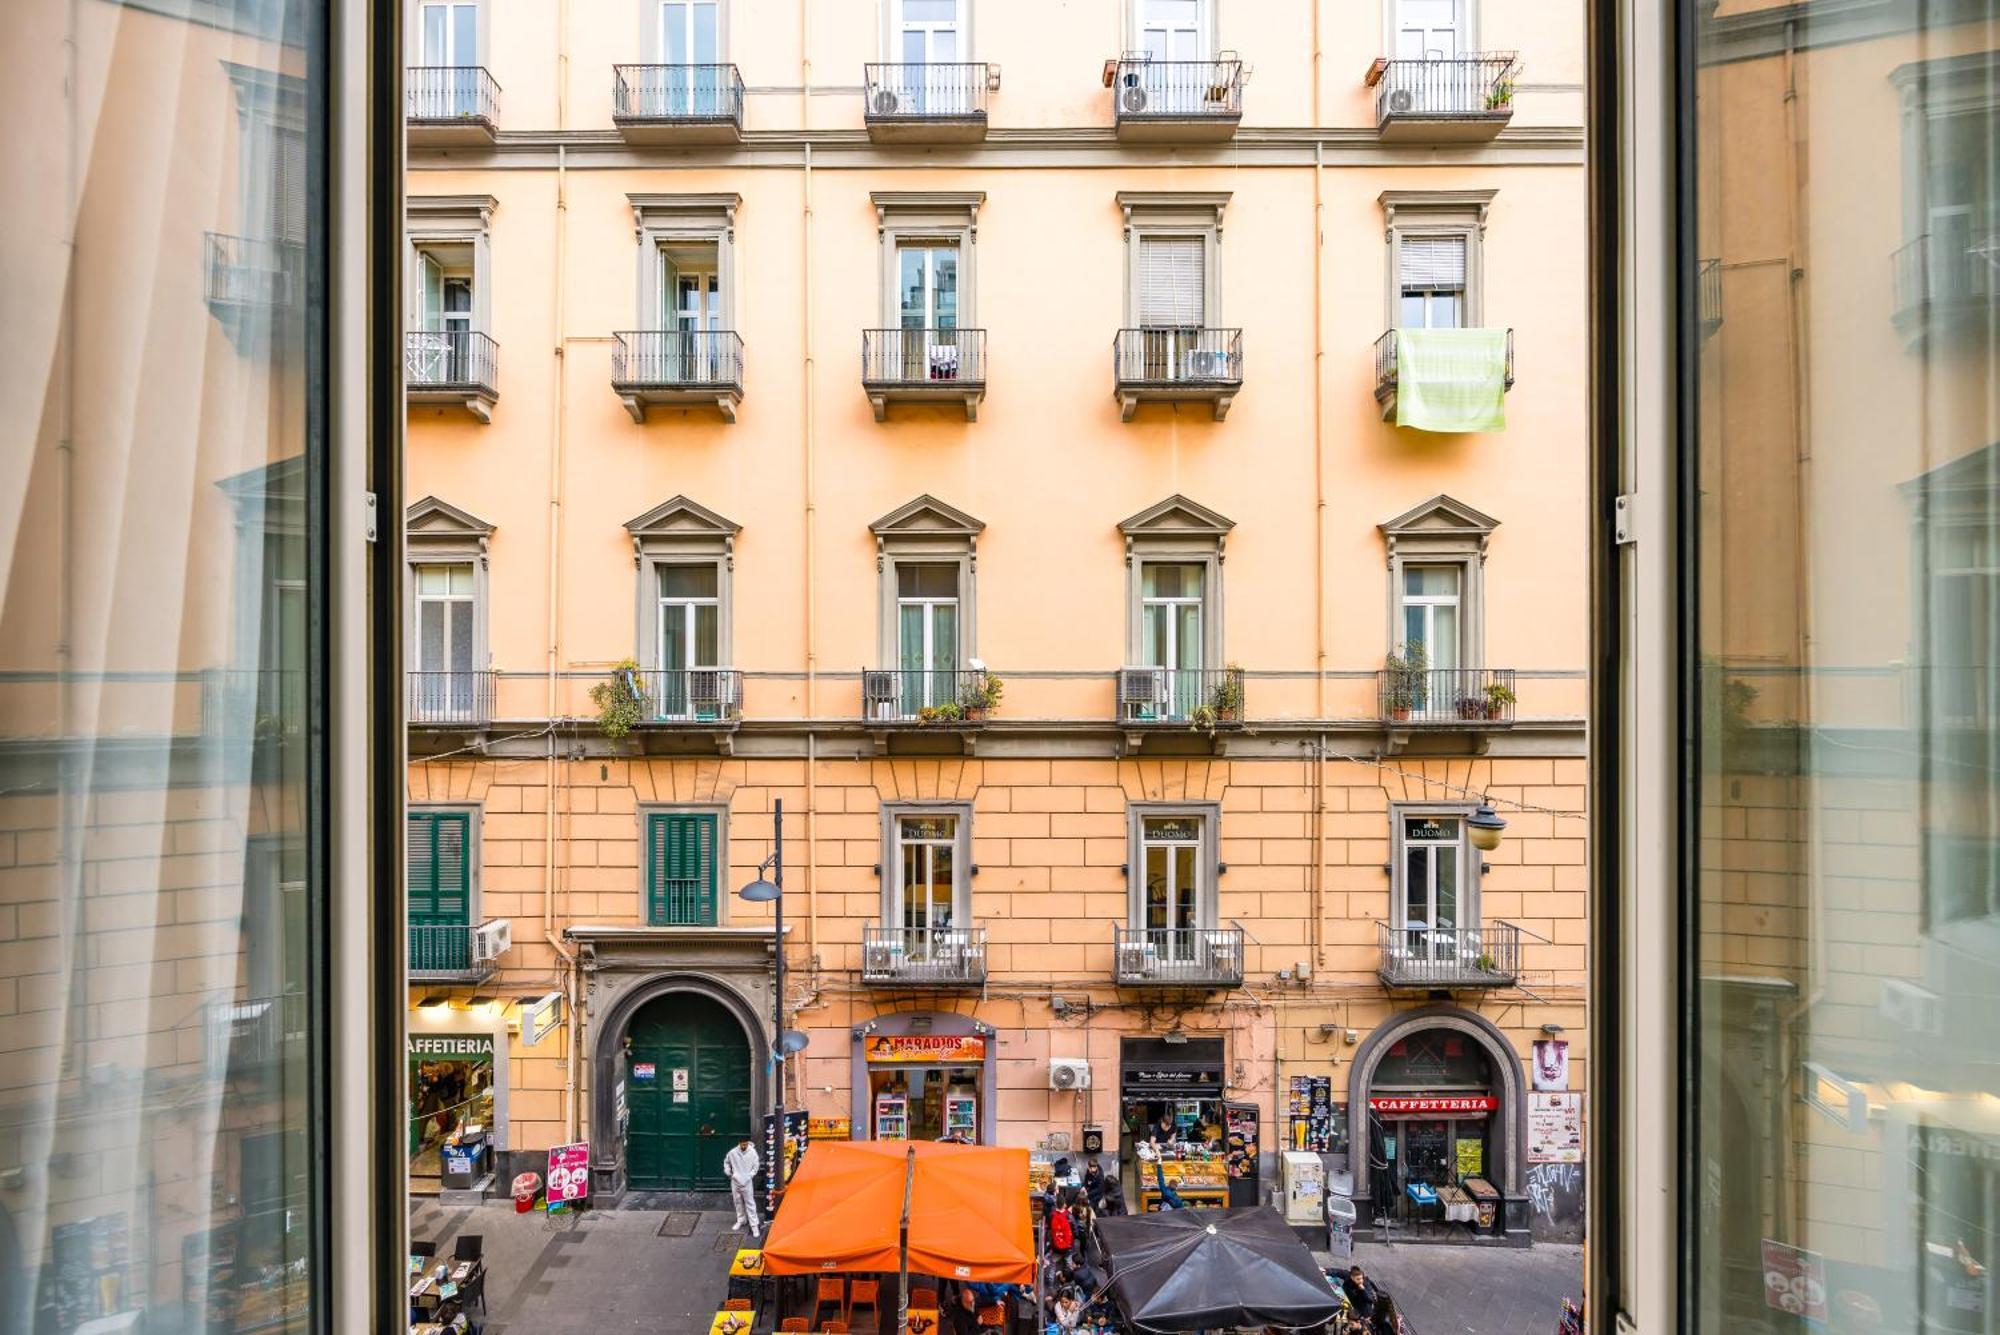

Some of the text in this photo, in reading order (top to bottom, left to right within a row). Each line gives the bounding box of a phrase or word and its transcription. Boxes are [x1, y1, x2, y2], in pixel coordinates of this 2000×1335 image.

[1152, 830, 1191, 839] DUOMO
[1412, 829, 1450, 837] DUOMO
[1378, 1100, 1487, 1110] CAFFETTERIA
